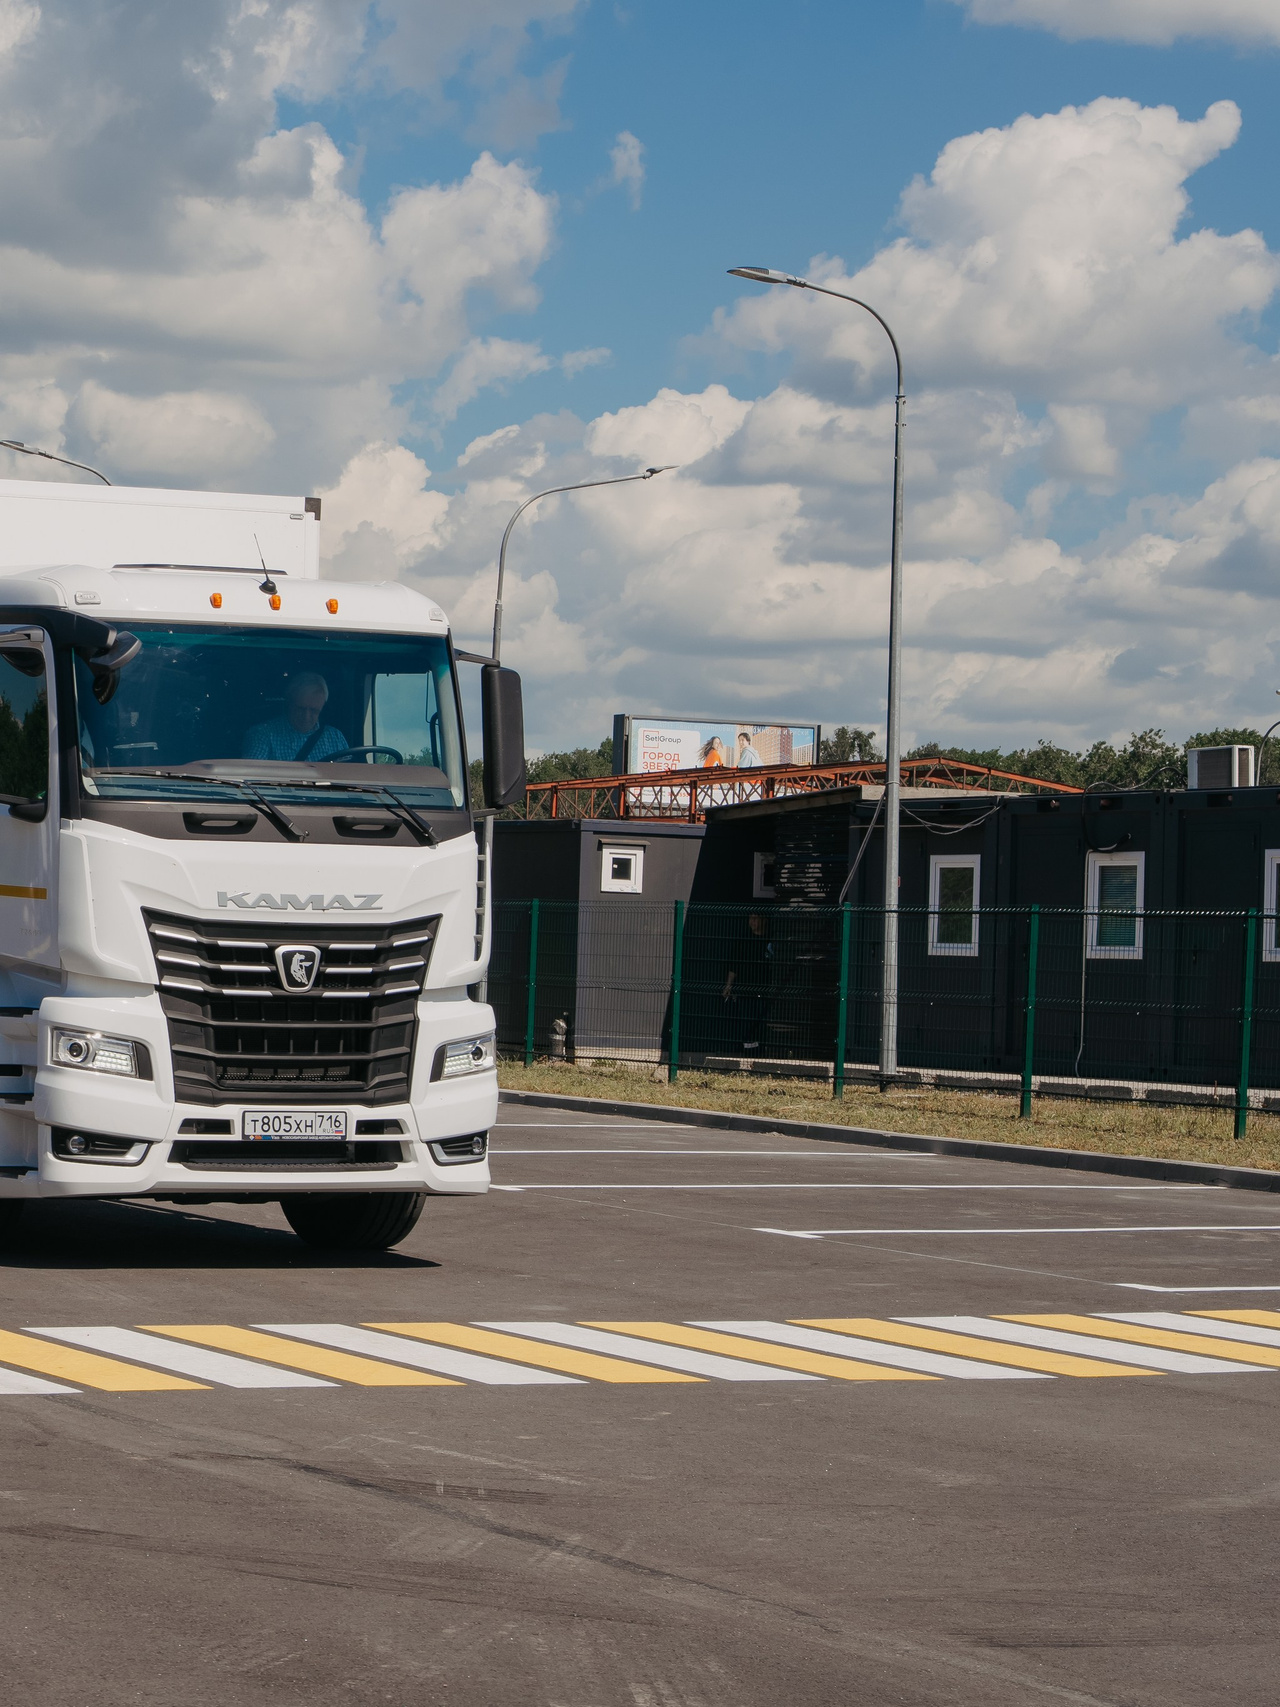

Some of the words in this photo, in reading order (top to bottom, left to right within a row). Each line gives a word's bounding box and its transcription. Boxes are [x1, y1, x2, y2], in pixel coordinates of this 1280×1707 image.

[643, 751, 680, 763] ГОРОД
[217, 891, 384, 911] KAMAZ
[251, 1115, 313, 1133] Т805ХН
[317, 1115, 342, 1128] 716
